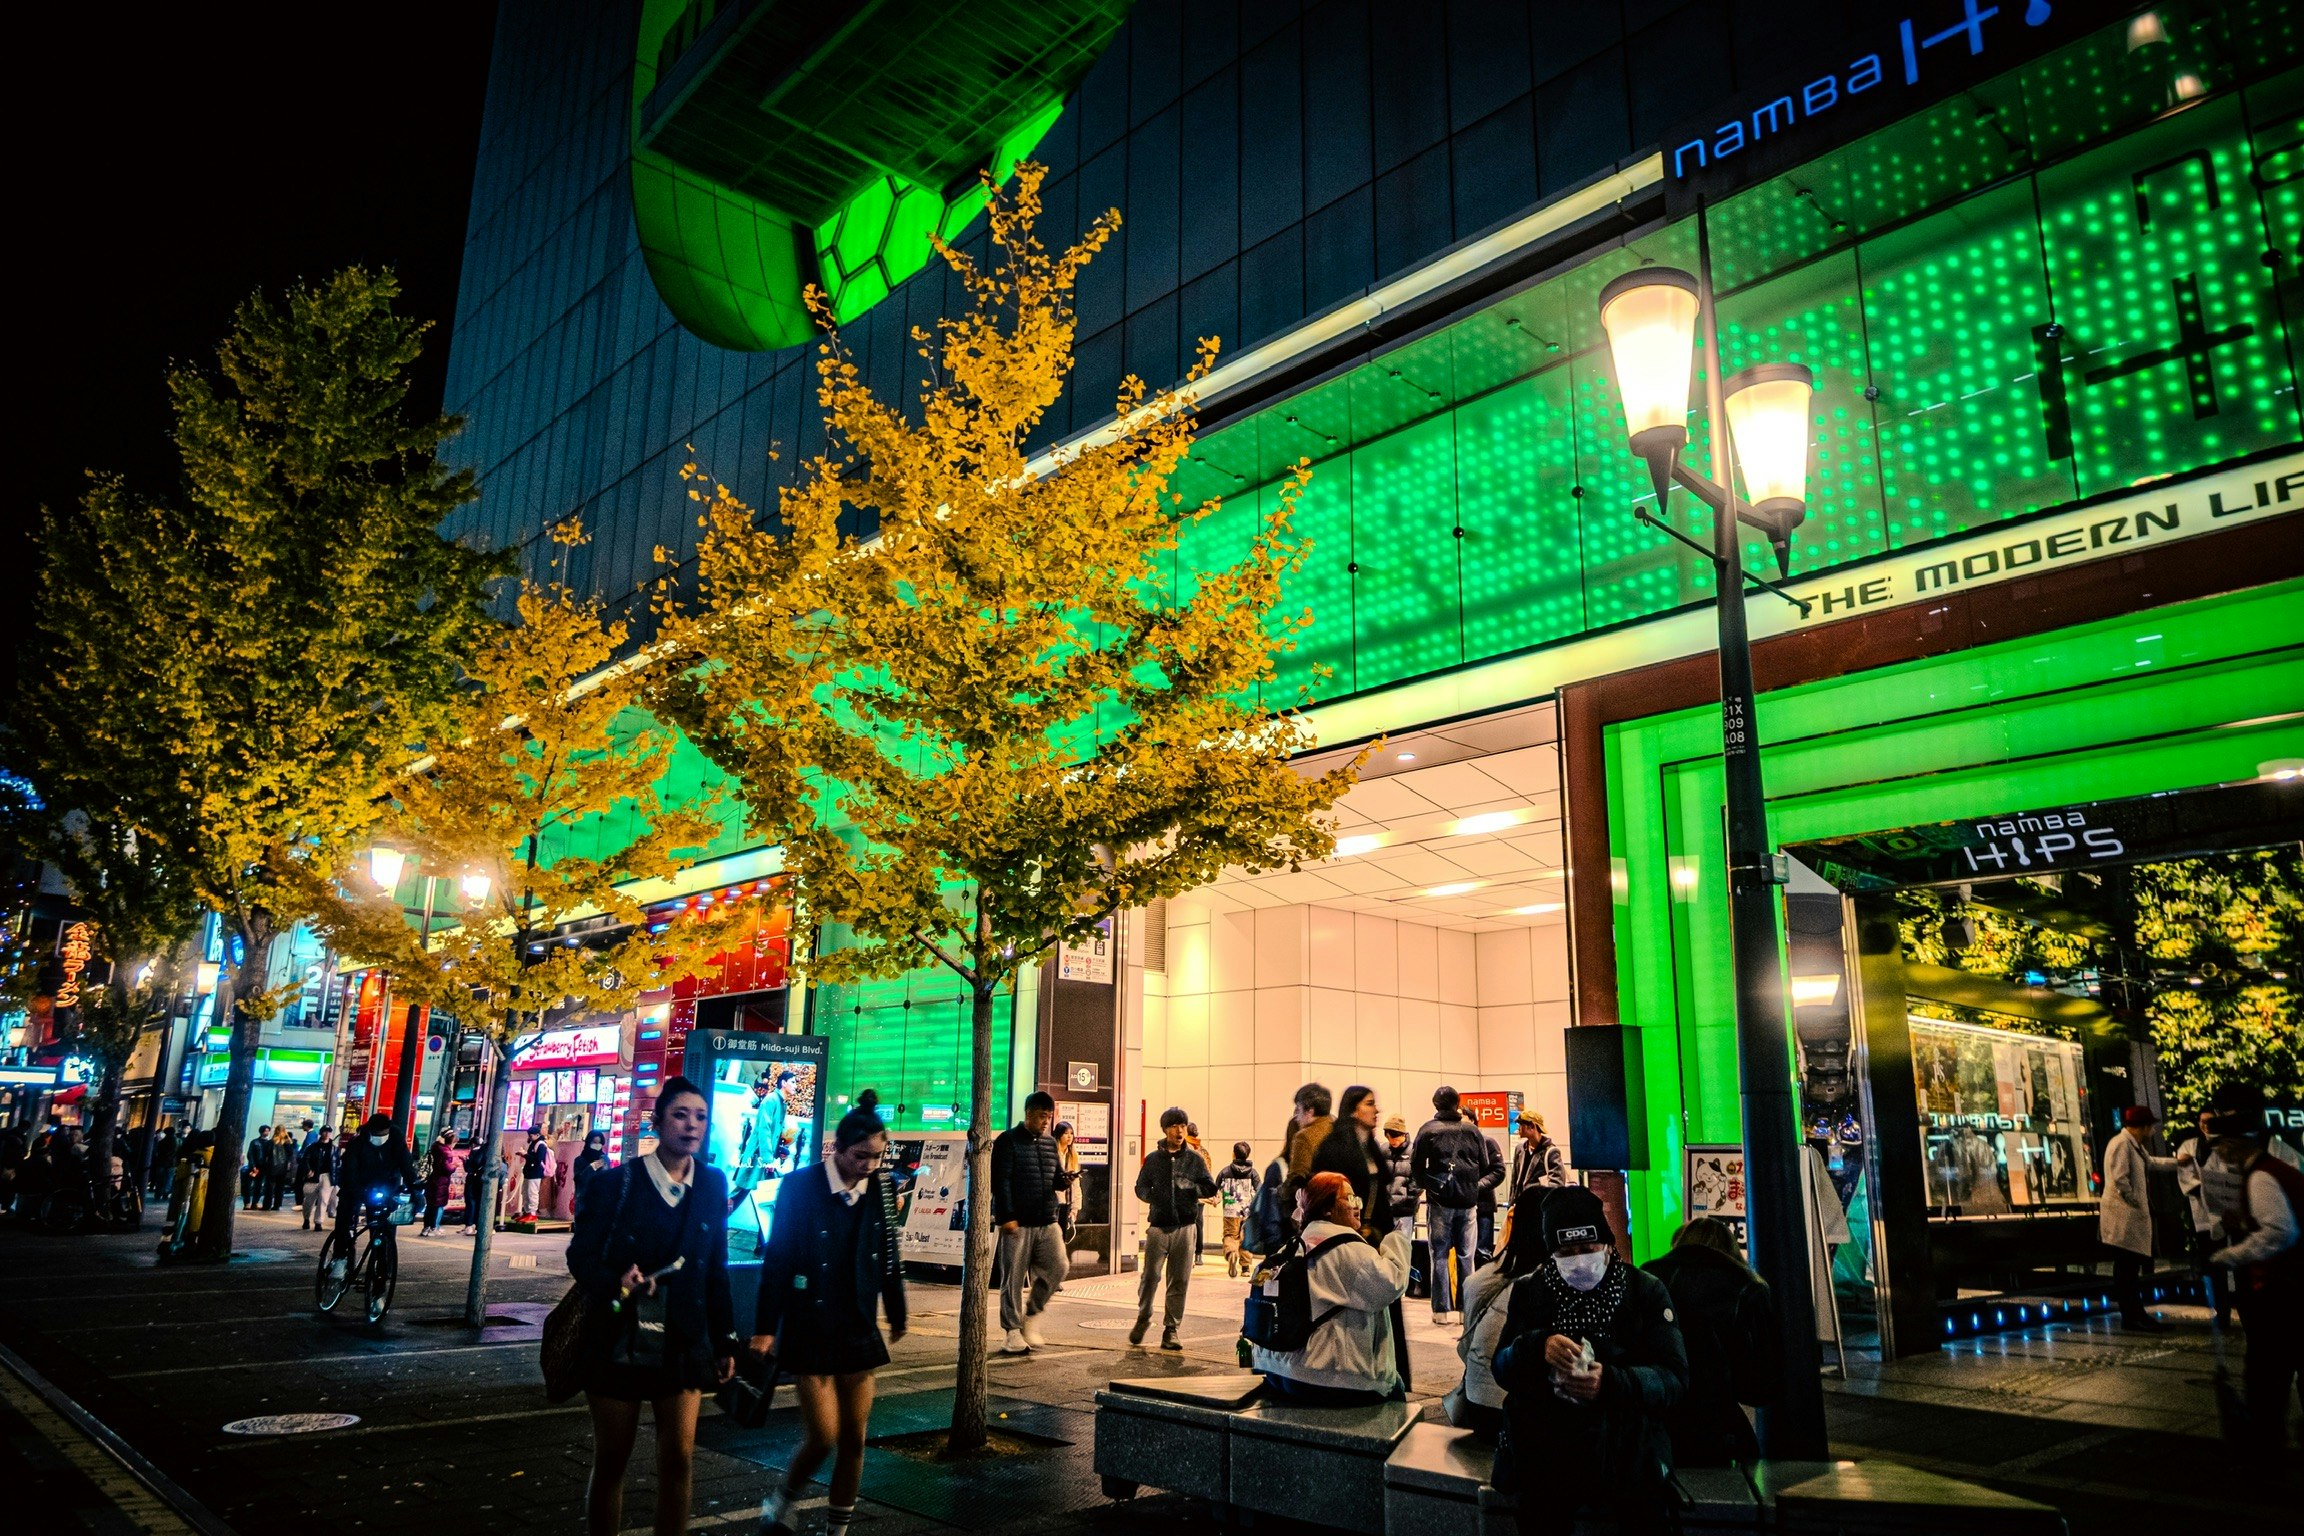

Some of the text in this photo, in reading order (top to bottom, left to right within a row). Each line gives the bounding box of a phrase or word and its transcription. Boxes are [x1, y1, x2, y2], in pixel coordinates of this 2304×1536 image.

[1788, 576, 1893, 621] THE
[1914, 503, 2180, 592] MODERN
[573, 1033, 599, 1059] Fetish
[727, 1039, 823, 1055] 御堂筋 Mido-suji Blvd.
